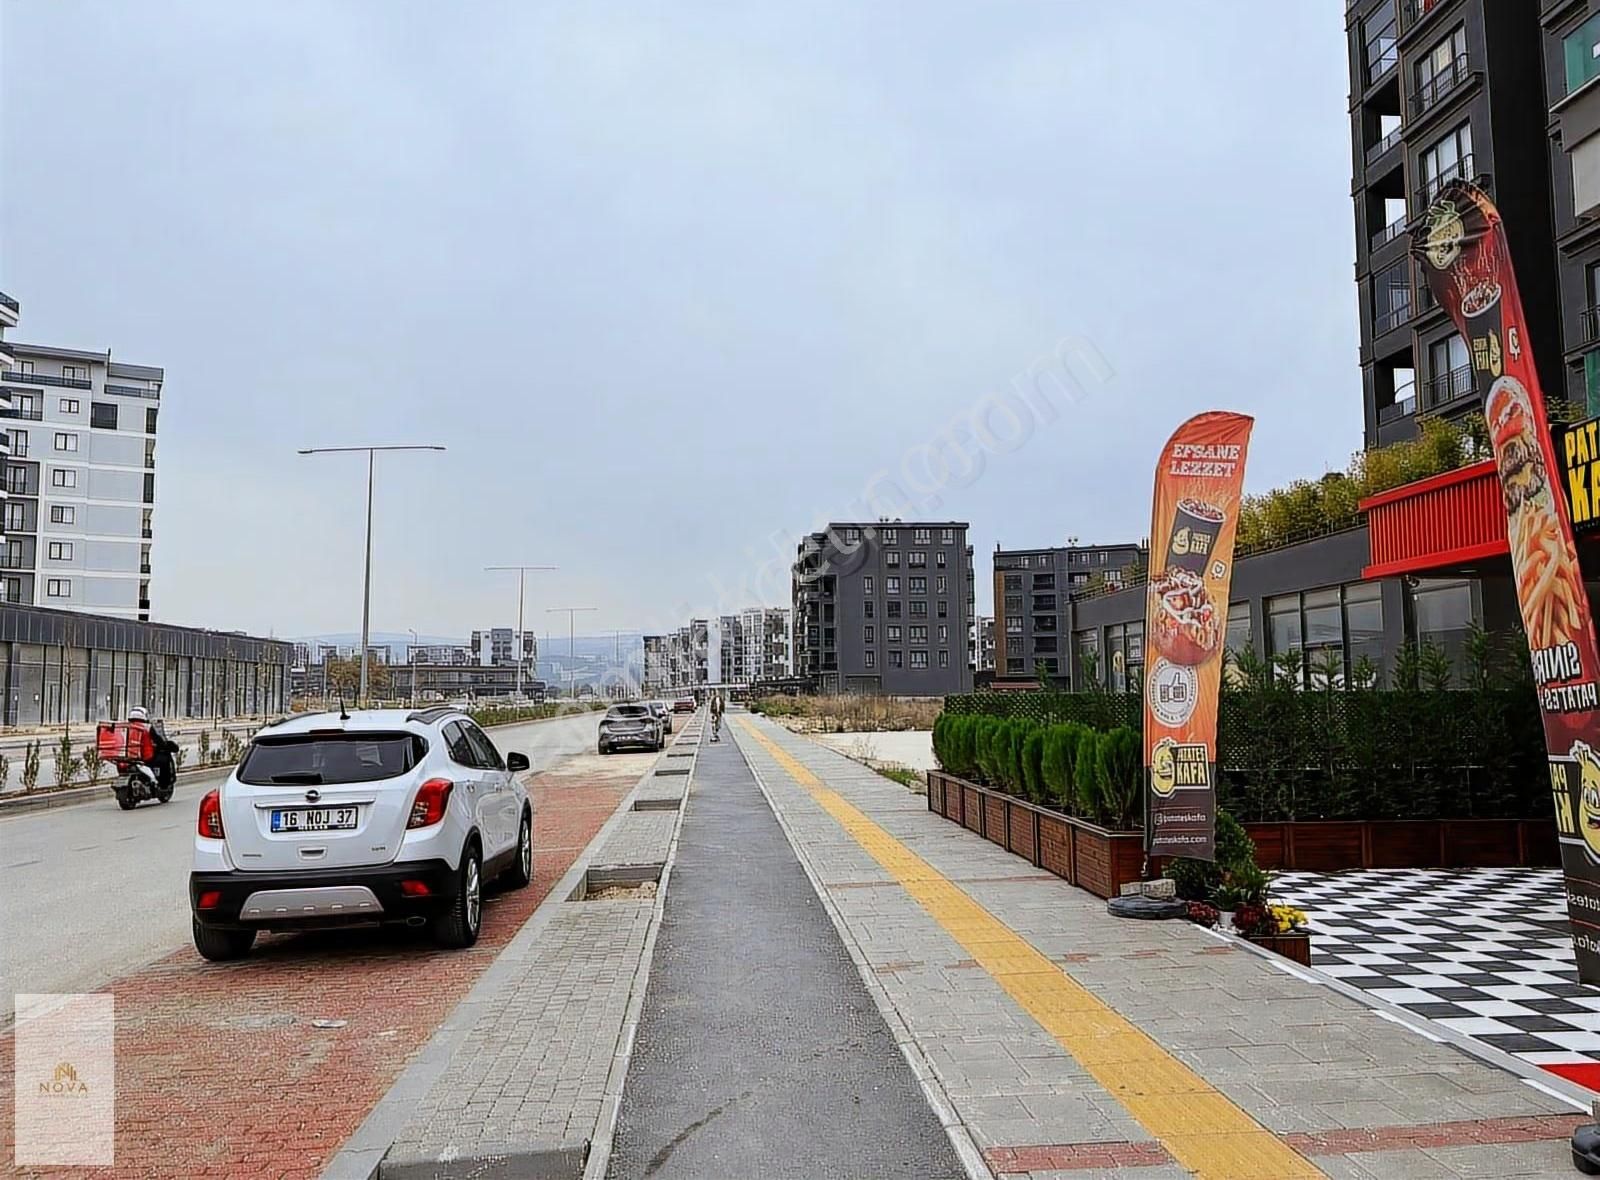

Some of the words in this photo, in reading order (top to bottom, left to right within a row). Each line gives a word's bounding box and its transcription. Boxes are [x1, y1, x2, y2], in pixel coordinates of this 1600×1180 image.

[1172, 444, 1240, 459] EFSANE
[1170, 461, 1235, 477] LEZZET
[1176, 762, 1206, 784] KAFA
[283, 812, 298, 827] 16
[337, 809, 353, 824] 37
